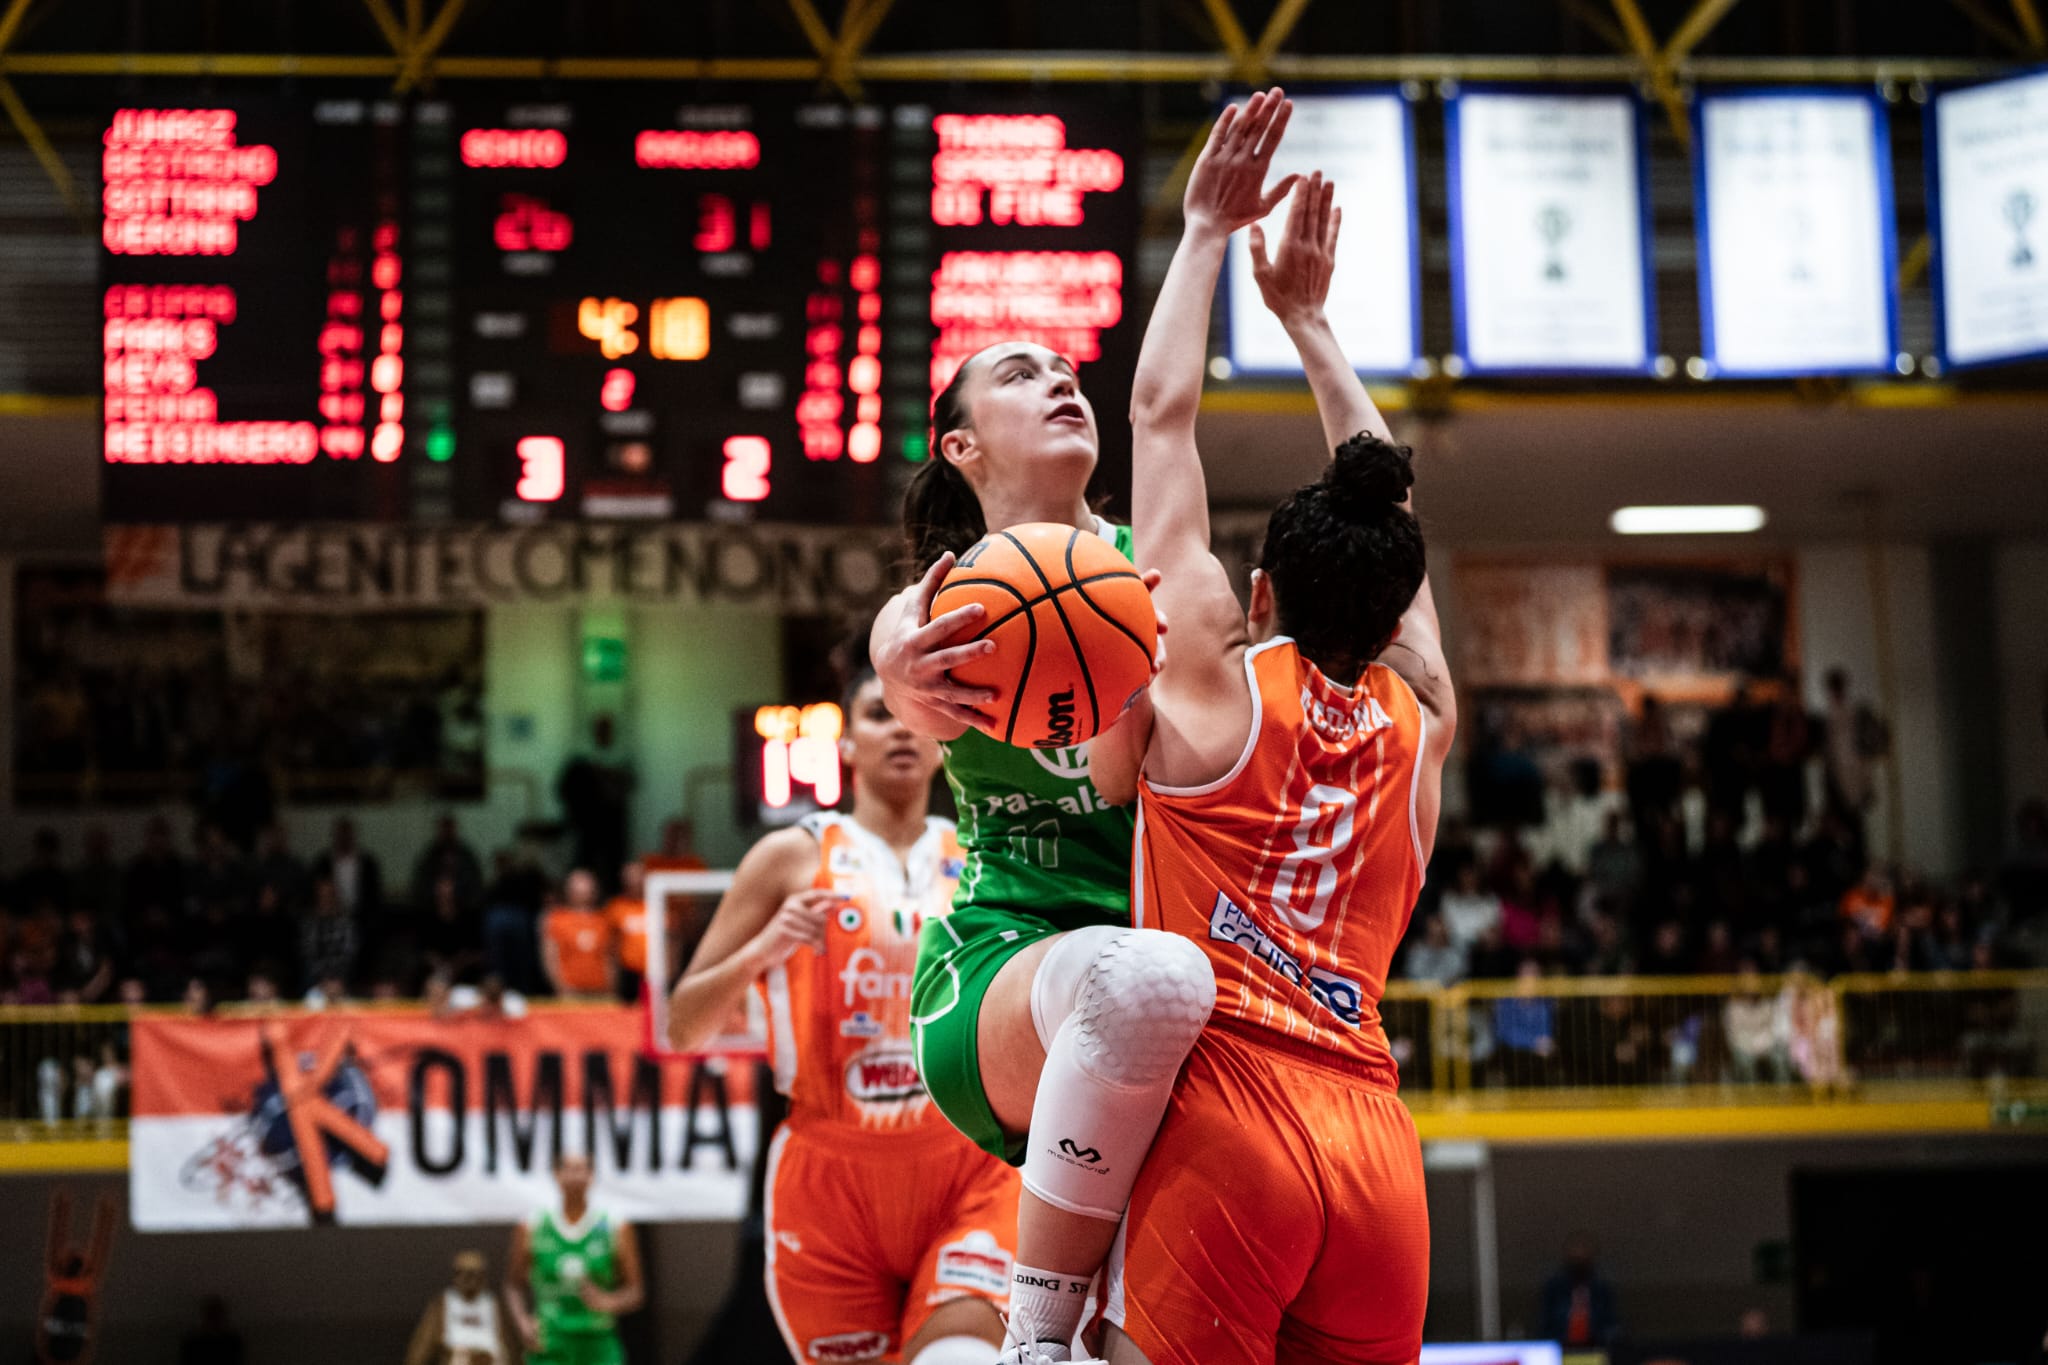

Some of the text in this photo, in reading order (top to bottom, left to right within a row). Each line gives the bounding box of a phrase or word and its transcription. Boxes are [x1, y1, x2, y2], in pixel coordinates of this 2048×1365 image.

[516, 436, 565, 501] 3
[722, 436, 771, 501] 2
[1270, 783, 1358, 933] 8
[1012, 1274, 1061, 1291] DING
